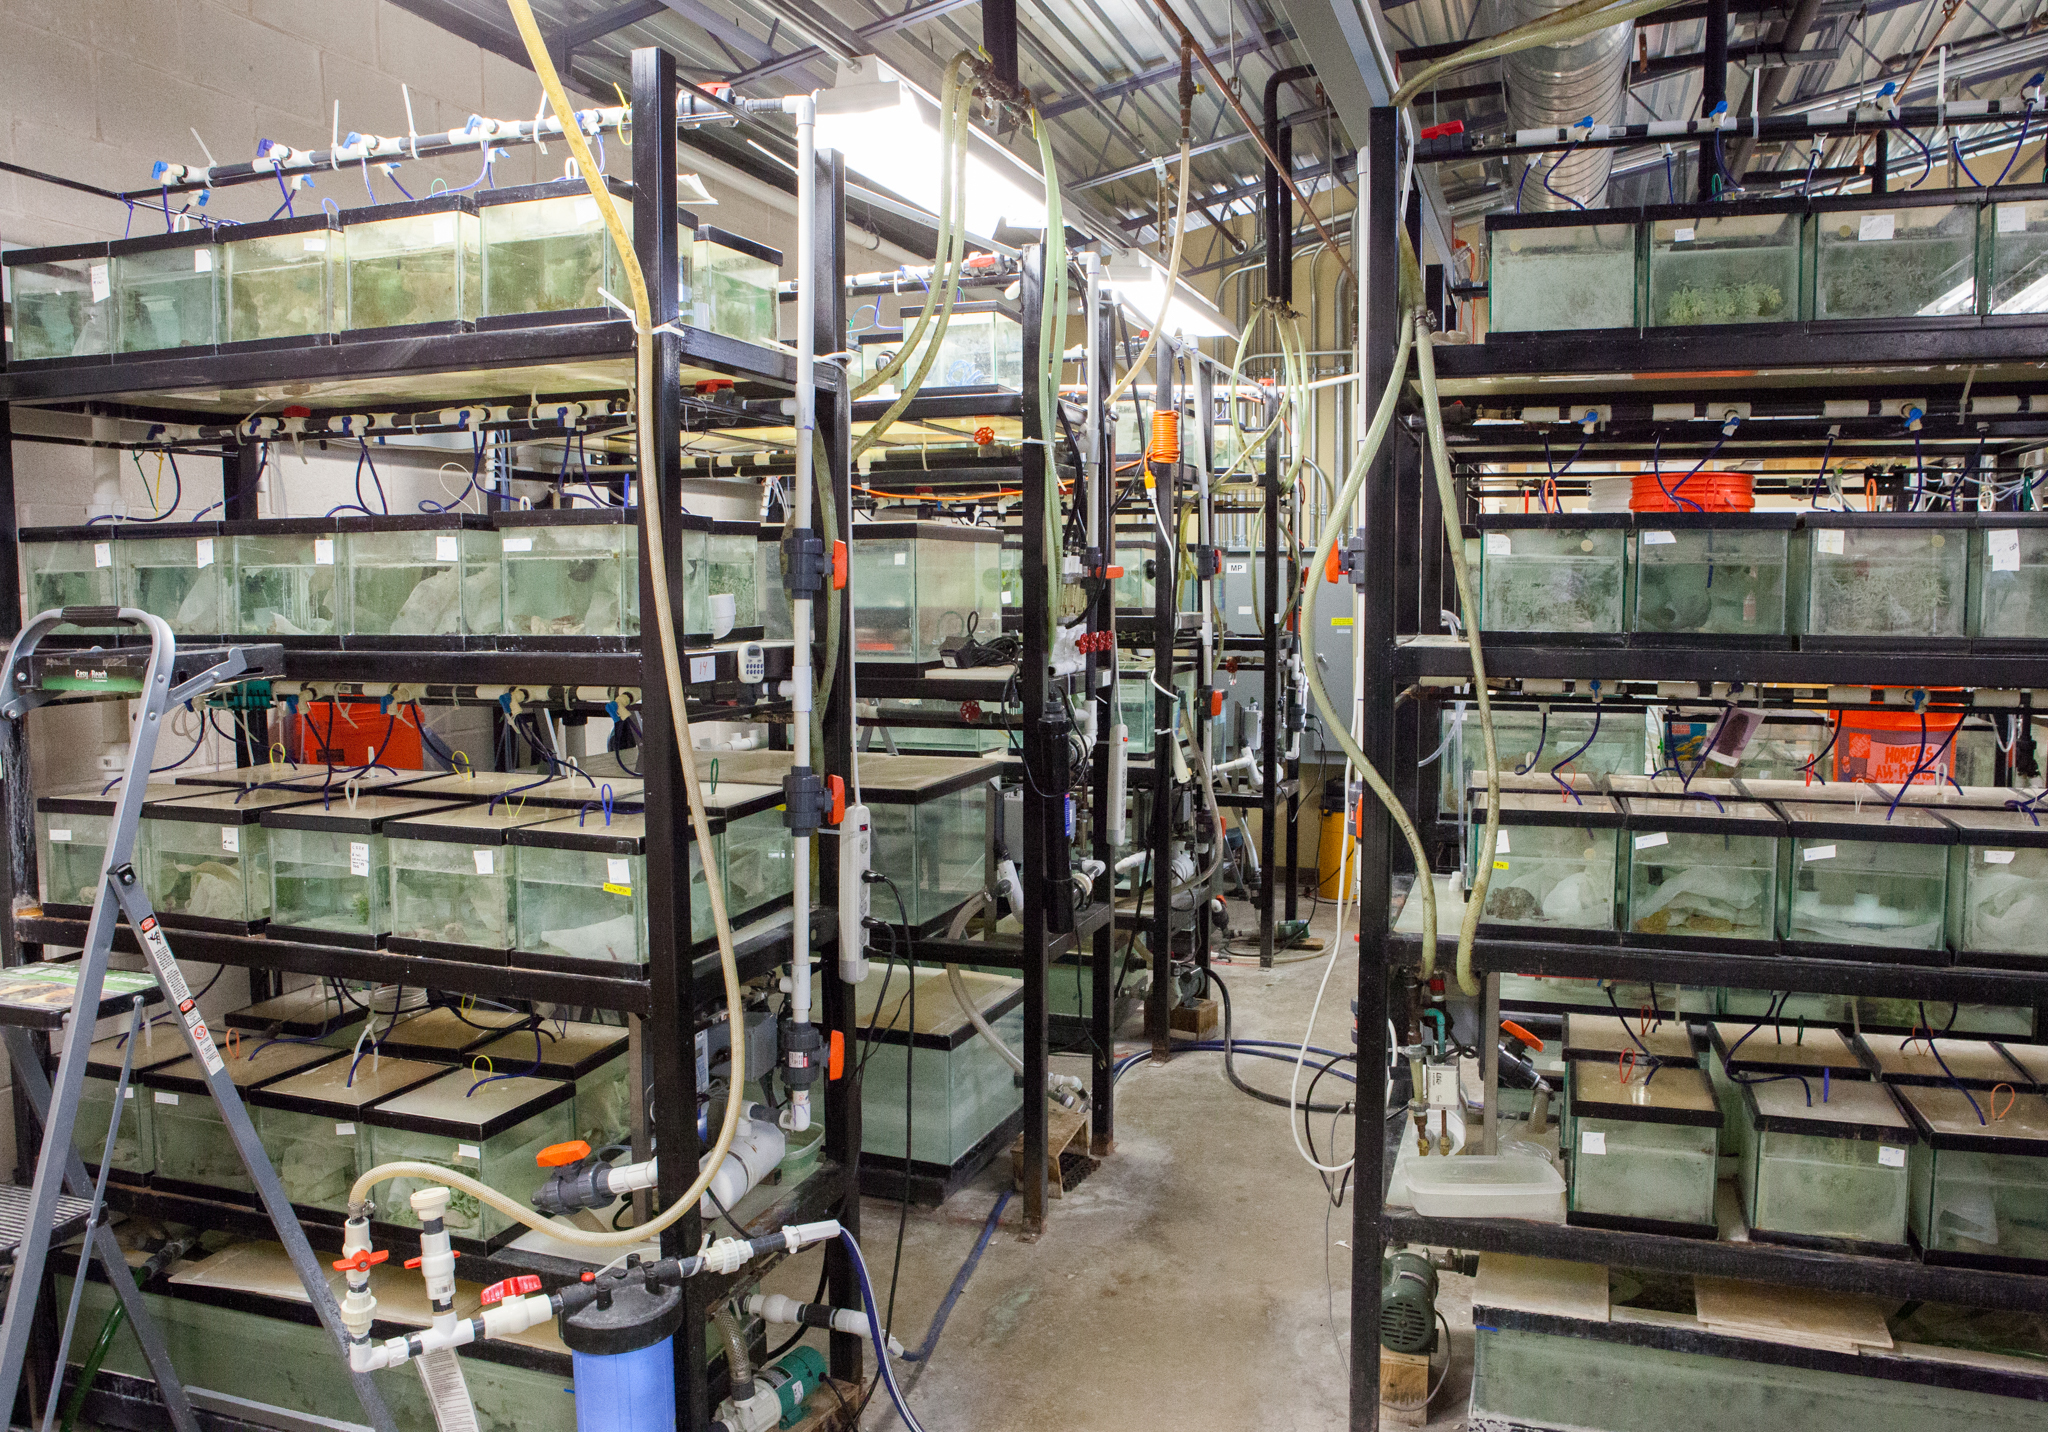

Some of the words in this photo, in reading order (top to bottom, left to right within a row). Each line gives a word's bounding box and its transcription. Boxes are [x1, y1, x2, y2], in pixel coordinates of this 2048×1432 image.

[75, 669, 89, 679] Easy
[91, 669, 108, 679] Reach
[699, 661, 708, 676] 14
[1885, 746, 1934, 764] HOMERS
